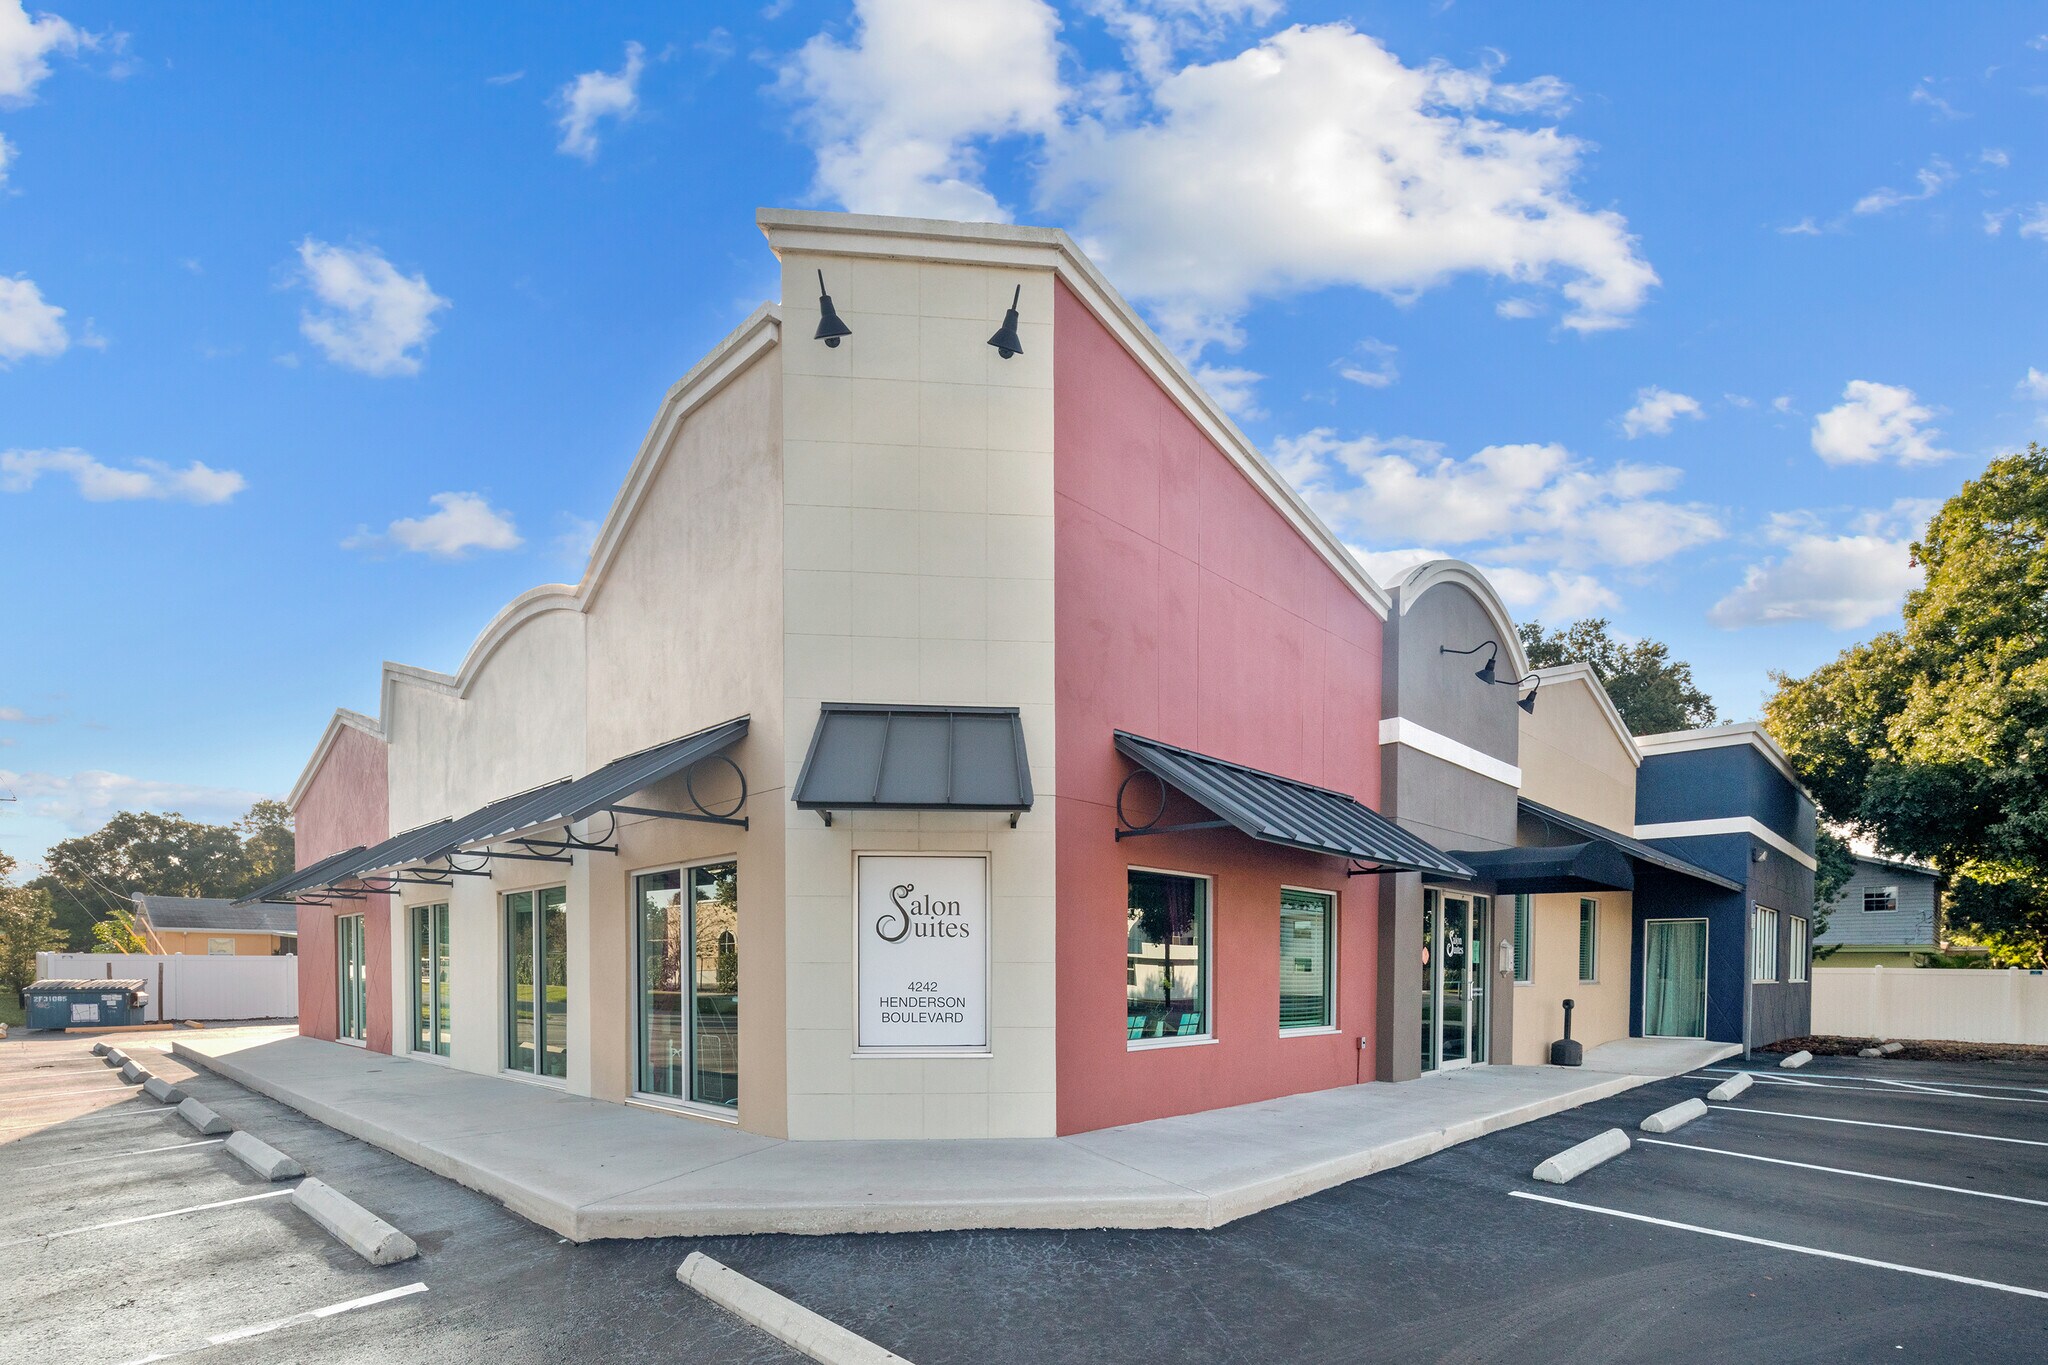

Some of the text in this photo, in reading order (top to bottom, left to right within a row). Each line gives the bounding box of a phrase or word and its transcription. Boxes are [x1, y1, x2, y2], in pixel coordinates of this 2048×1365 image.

[876, 884, 961, 943] Salon
[907, 982, 938, 992] 4242
[880, 997, 966, 1008] HENDERSON
[881, 1012, 964, 1024] BOULEVARD
